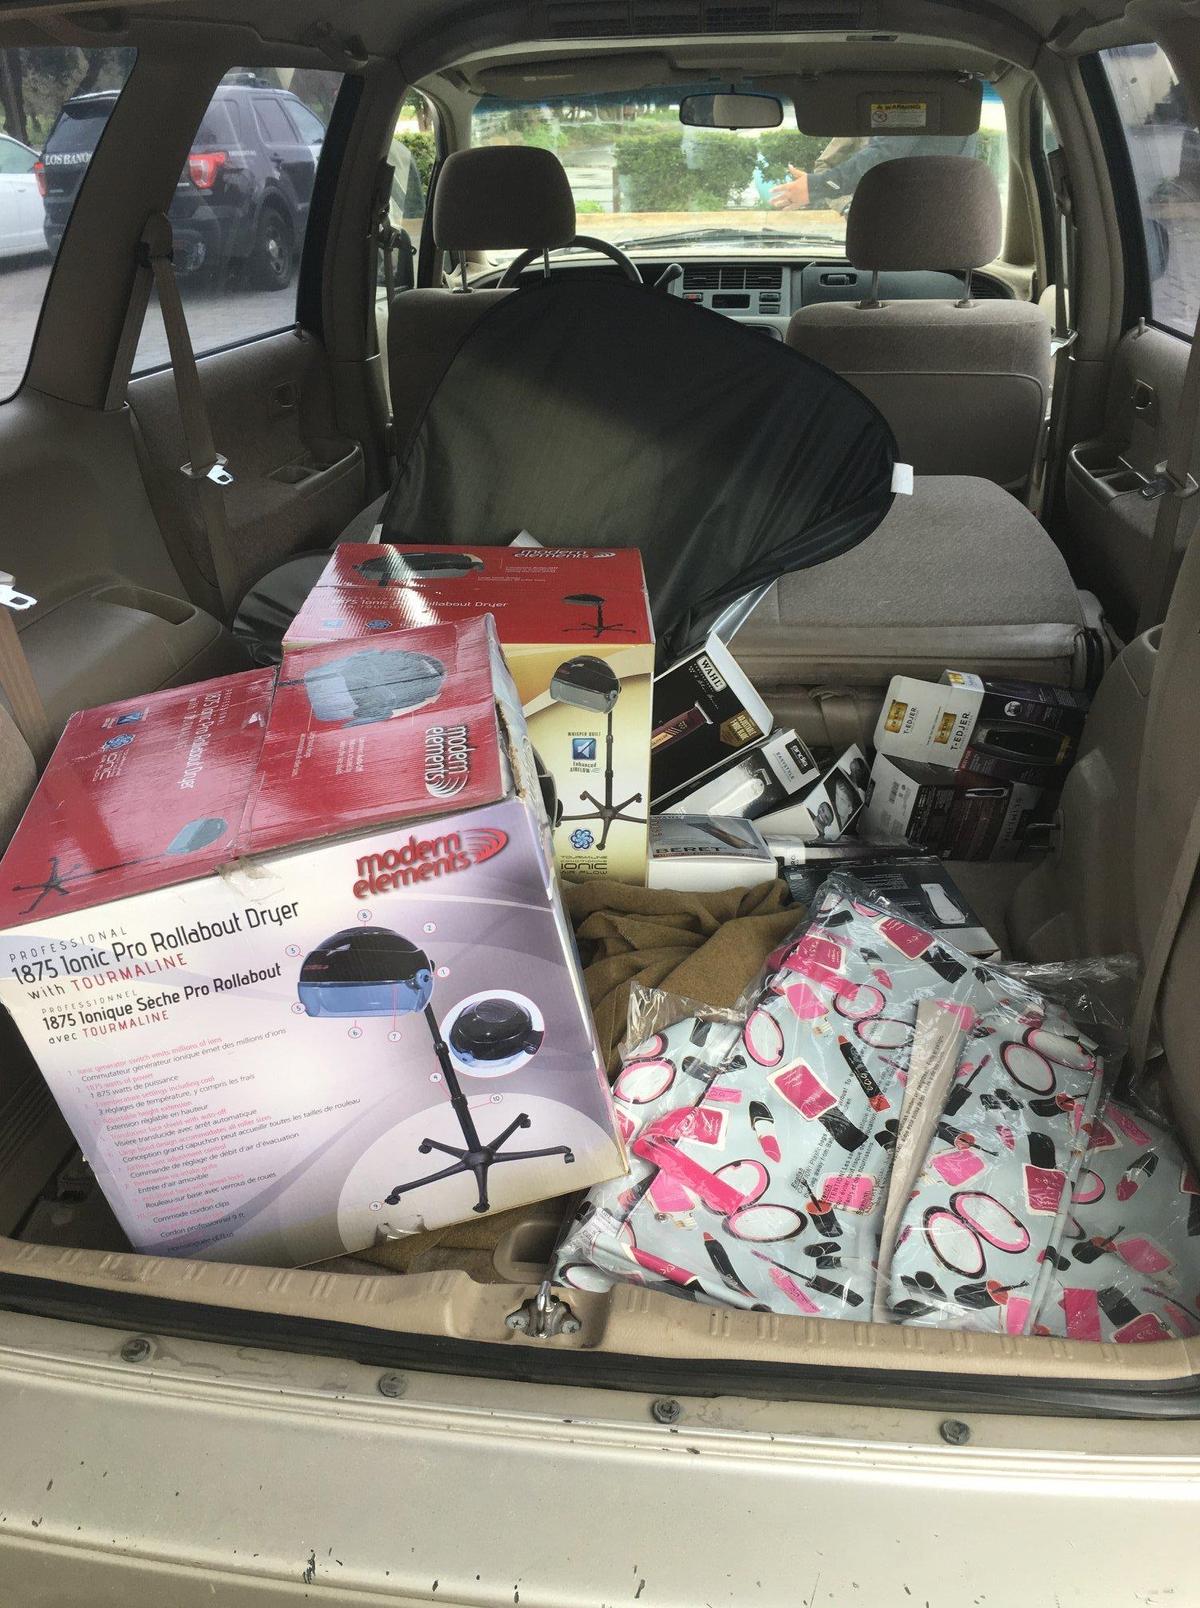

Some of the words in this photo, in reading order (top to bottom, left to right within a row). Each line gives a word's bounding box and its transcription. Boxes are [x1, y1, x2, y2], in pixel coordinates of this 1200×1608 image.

[44, 153, 62, 165] LOS
[63, 152, 92, 165] BANO
[701, 659, 721, 688] WAHL
[425, 726, 449, 781] elements
[447, 725, 476, 775] modern
[356, 833, 461, 876] modern
[353, 850, 472, 899] elements
[9, 926, 128, 962] PROFESSIONAL
[11, 959, 57, 985] 1875
[62, 949, 110, 975] Ionic
[113, 941, 147, 963] Pro
[150, 913, 242, 954] Rollabout
[245, 901, 300, 929] Dryer
[27, 983, 65, 1000] with
[70, 953, 187, 992] TOURMALINE
[41, 989, 137, 1014] PROFESSIONNEL
[42, 1012, 77, 1031] 1875
[80, 1002, 133, 1026] Ionique
[136, 991, 180, 1012] Sèche
[184, 984, 209, 999] Pro
[213, 962, 282, 993] Rollabout
[48, 1031, 78, 1045] avec
[82, 1010, 169, 1039] TOURMALINE
[82, 1068, 130, 1081] Commutateur
[222, 1042, 234, 1050] des
[236, 1034, 263, 1046] millions
[96, 1090, 110, 1098] 875
[113, 1086, 132, 1095] watts
[134, 1082, 142, 1090] de
[145, 1075, 178, 1088] puissance
[107, 1120, 139, 1131] Extension
[181, 1104, 208, 1116] hauteur
[136, 1100, 145, 1108] de
[123, 1150, 161, 1163] Conception
[163, 1144, 183, 1156] grand
[185, 1135, 220, 1150] capuchon
[220, 1131, 237, 1141] peut
[269, 1117, 291, 1127] toutes
[335, 1098, 361, 1109] rouleau
[178, 1125, 192, 1134] avec
[212, 1109, 257, 1125] automatique
[130, 1165, 170, 1179] Commande
[171, 1162, 180, 1170] de
[209, 1153, 218, 1161] de
[138, 1184, 160, 1194] Entrée
[205, 1185, 219, 1195] avec
[258, 1172, 276, 1181] roues
[153, 1211, 189, 1223] Commode
[190, 1203, 214, 1214] cordon
